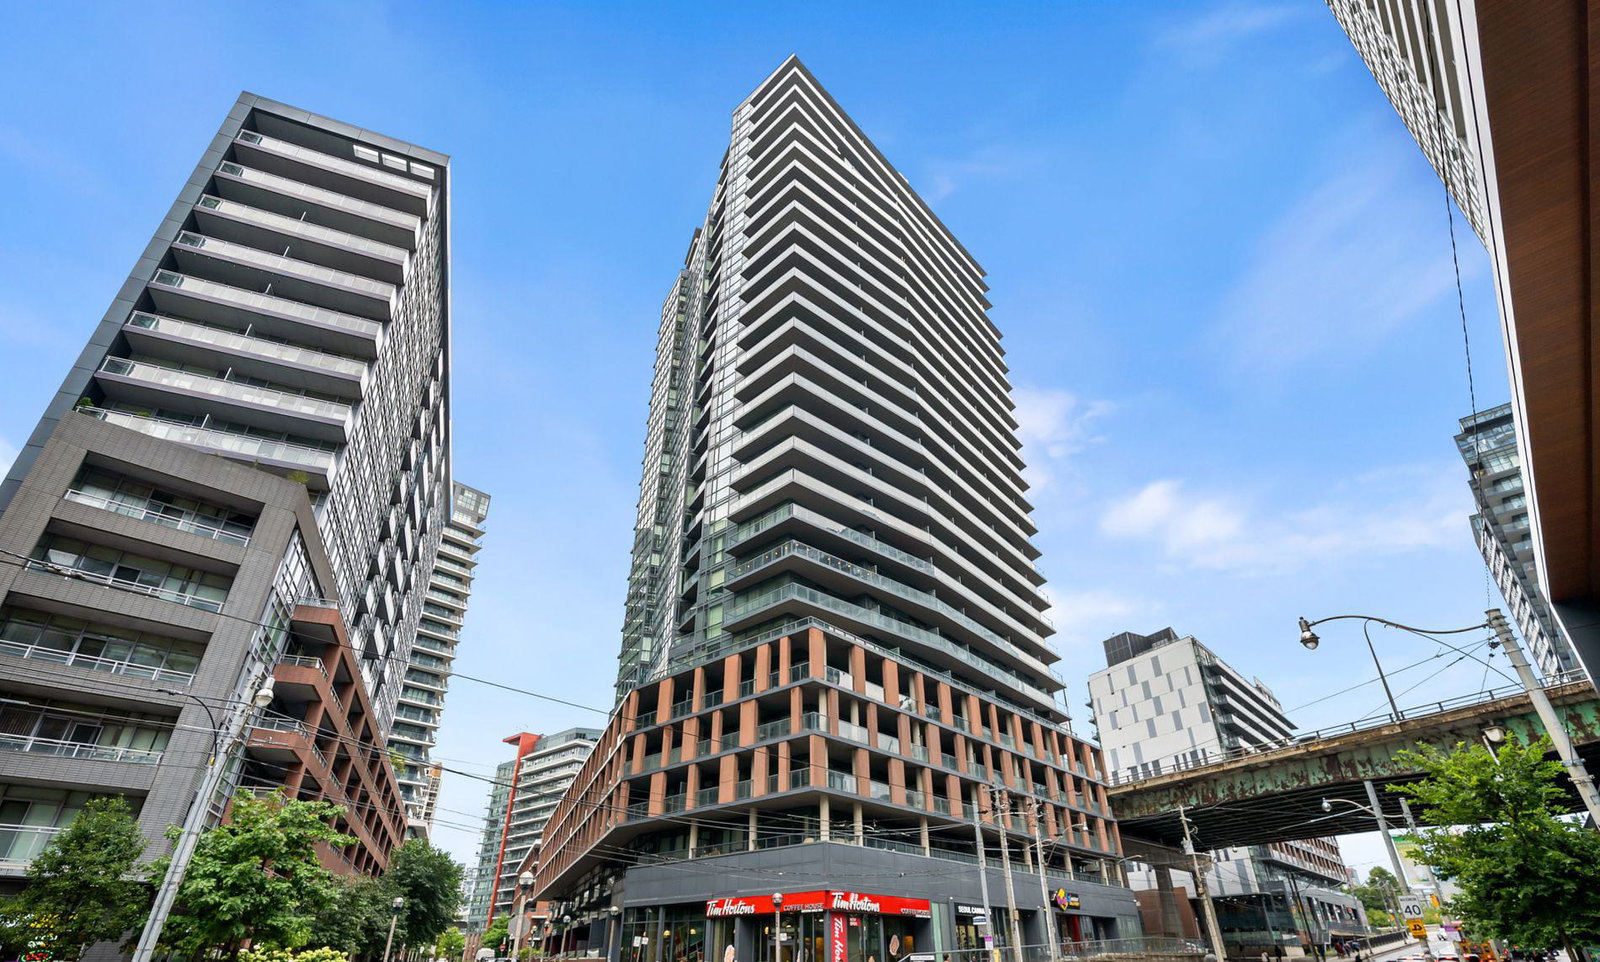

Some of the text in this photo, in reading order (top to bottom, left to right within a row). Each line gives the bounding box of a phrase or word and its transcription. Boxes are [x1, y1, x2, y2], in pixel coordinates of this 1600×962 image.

[706, 898, 756, 917] Tim Hortons
[831, 892, 880, 912] Tim Hortons
[958, 905, 972, 914] SEOUL
[1404, 904, 1421, 916] 40
[834, 917, 844, 939] Tim
